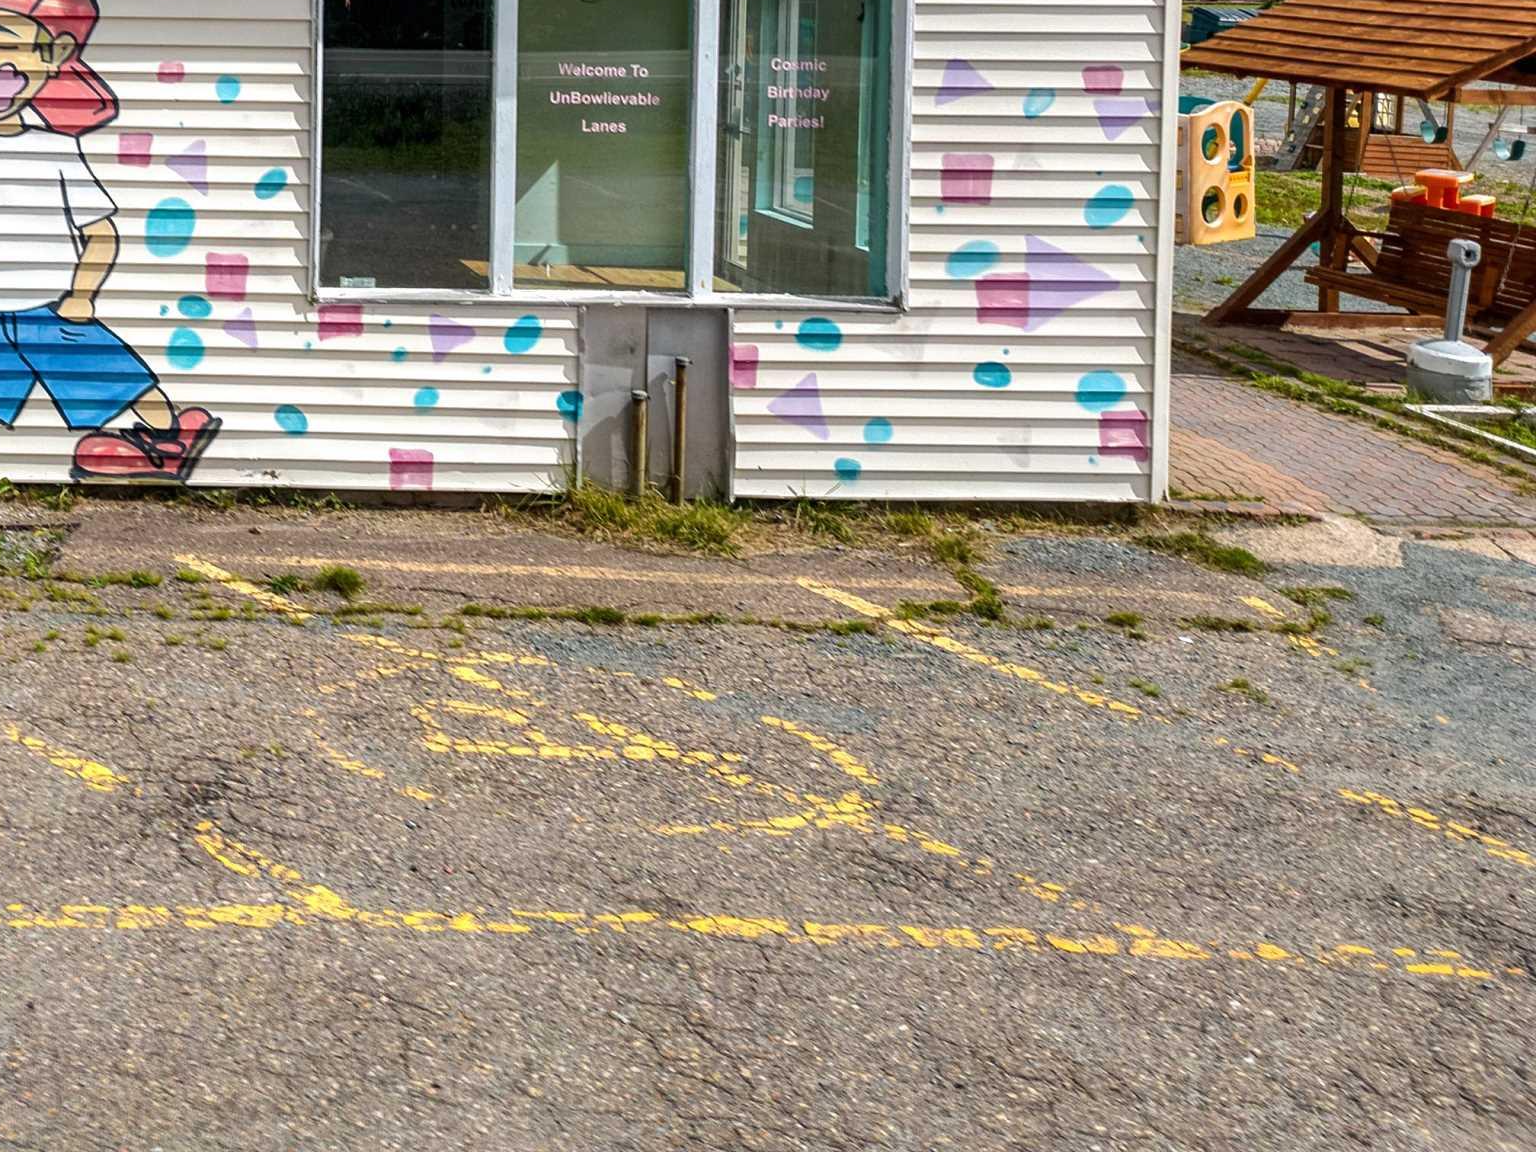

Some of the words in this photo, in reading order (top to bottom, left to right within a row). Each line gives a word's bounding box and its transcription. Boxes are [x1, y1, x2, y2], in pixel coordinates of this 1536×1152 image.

[558, 62, 626, 78] Welcome
[630, 63, 649, 78] To
[771, 58, 827, 72] Cosmic
[550, 91, 660, 106] UnBowlievable
[767, 85, 830, 102] Birthday
[581, 119, 627, 133] Lanes
[767, 114, 825, 129] Parties!
